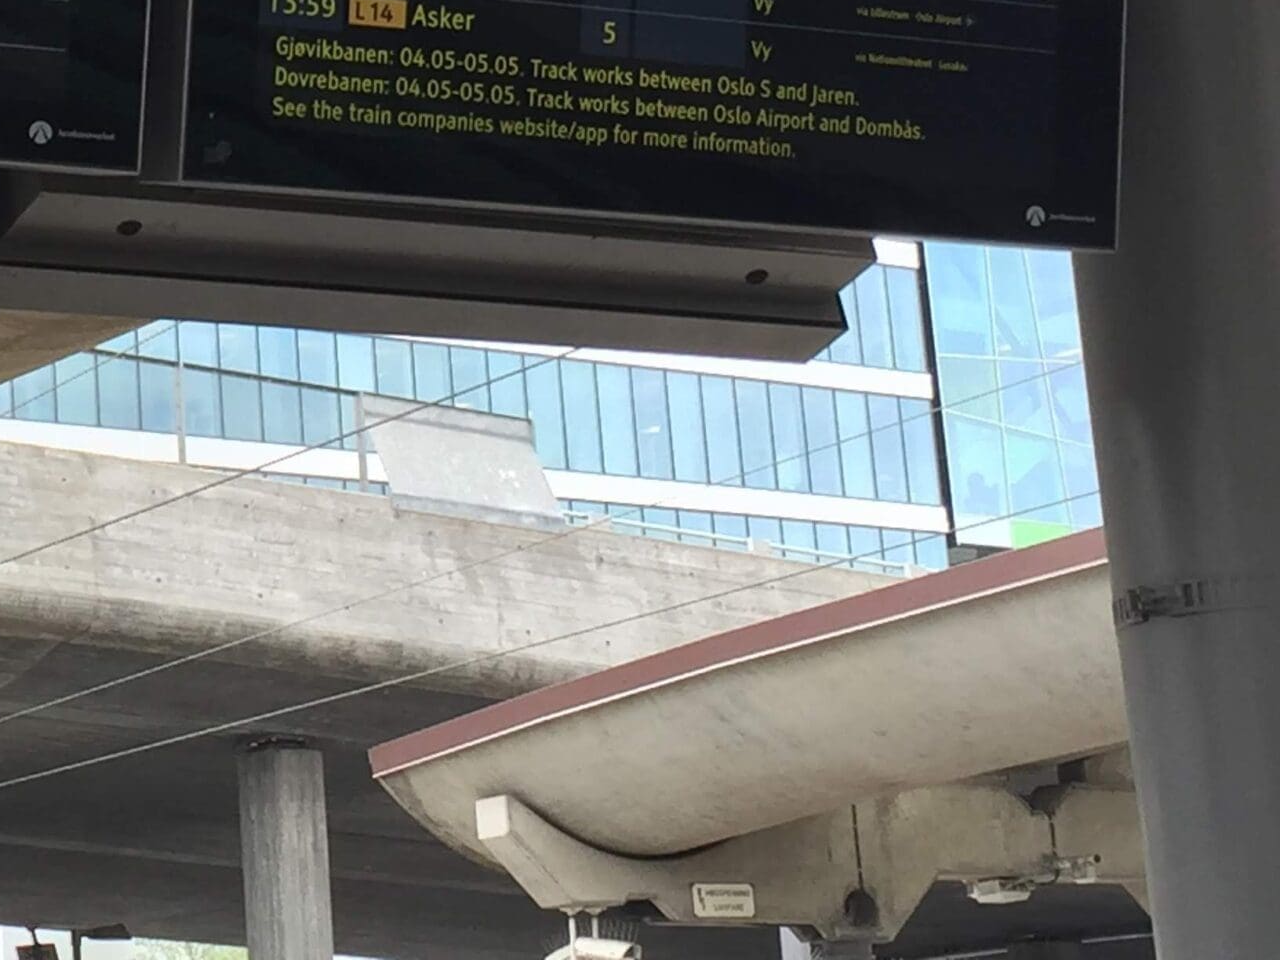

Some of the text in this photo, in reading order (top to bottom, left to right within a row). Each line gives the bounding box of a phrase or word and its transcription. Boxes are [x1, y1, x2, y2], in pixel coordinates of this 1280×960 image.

[412, 5, 475, 30] Asker
[604, 22, 615, 43] 5
[751, 41, 771, 61] Vy
[275, 66, 925, 139] Dovrebanen: 04.05-05.05. Track works between Oslo Airport and Dombås.
[276, 36, 859, 107] Gjøvikbanen: 04.05-05.05. Track works between Oslo S and Jaren.
[273, 97, 795, 157] See the train companies website/app for more information.
